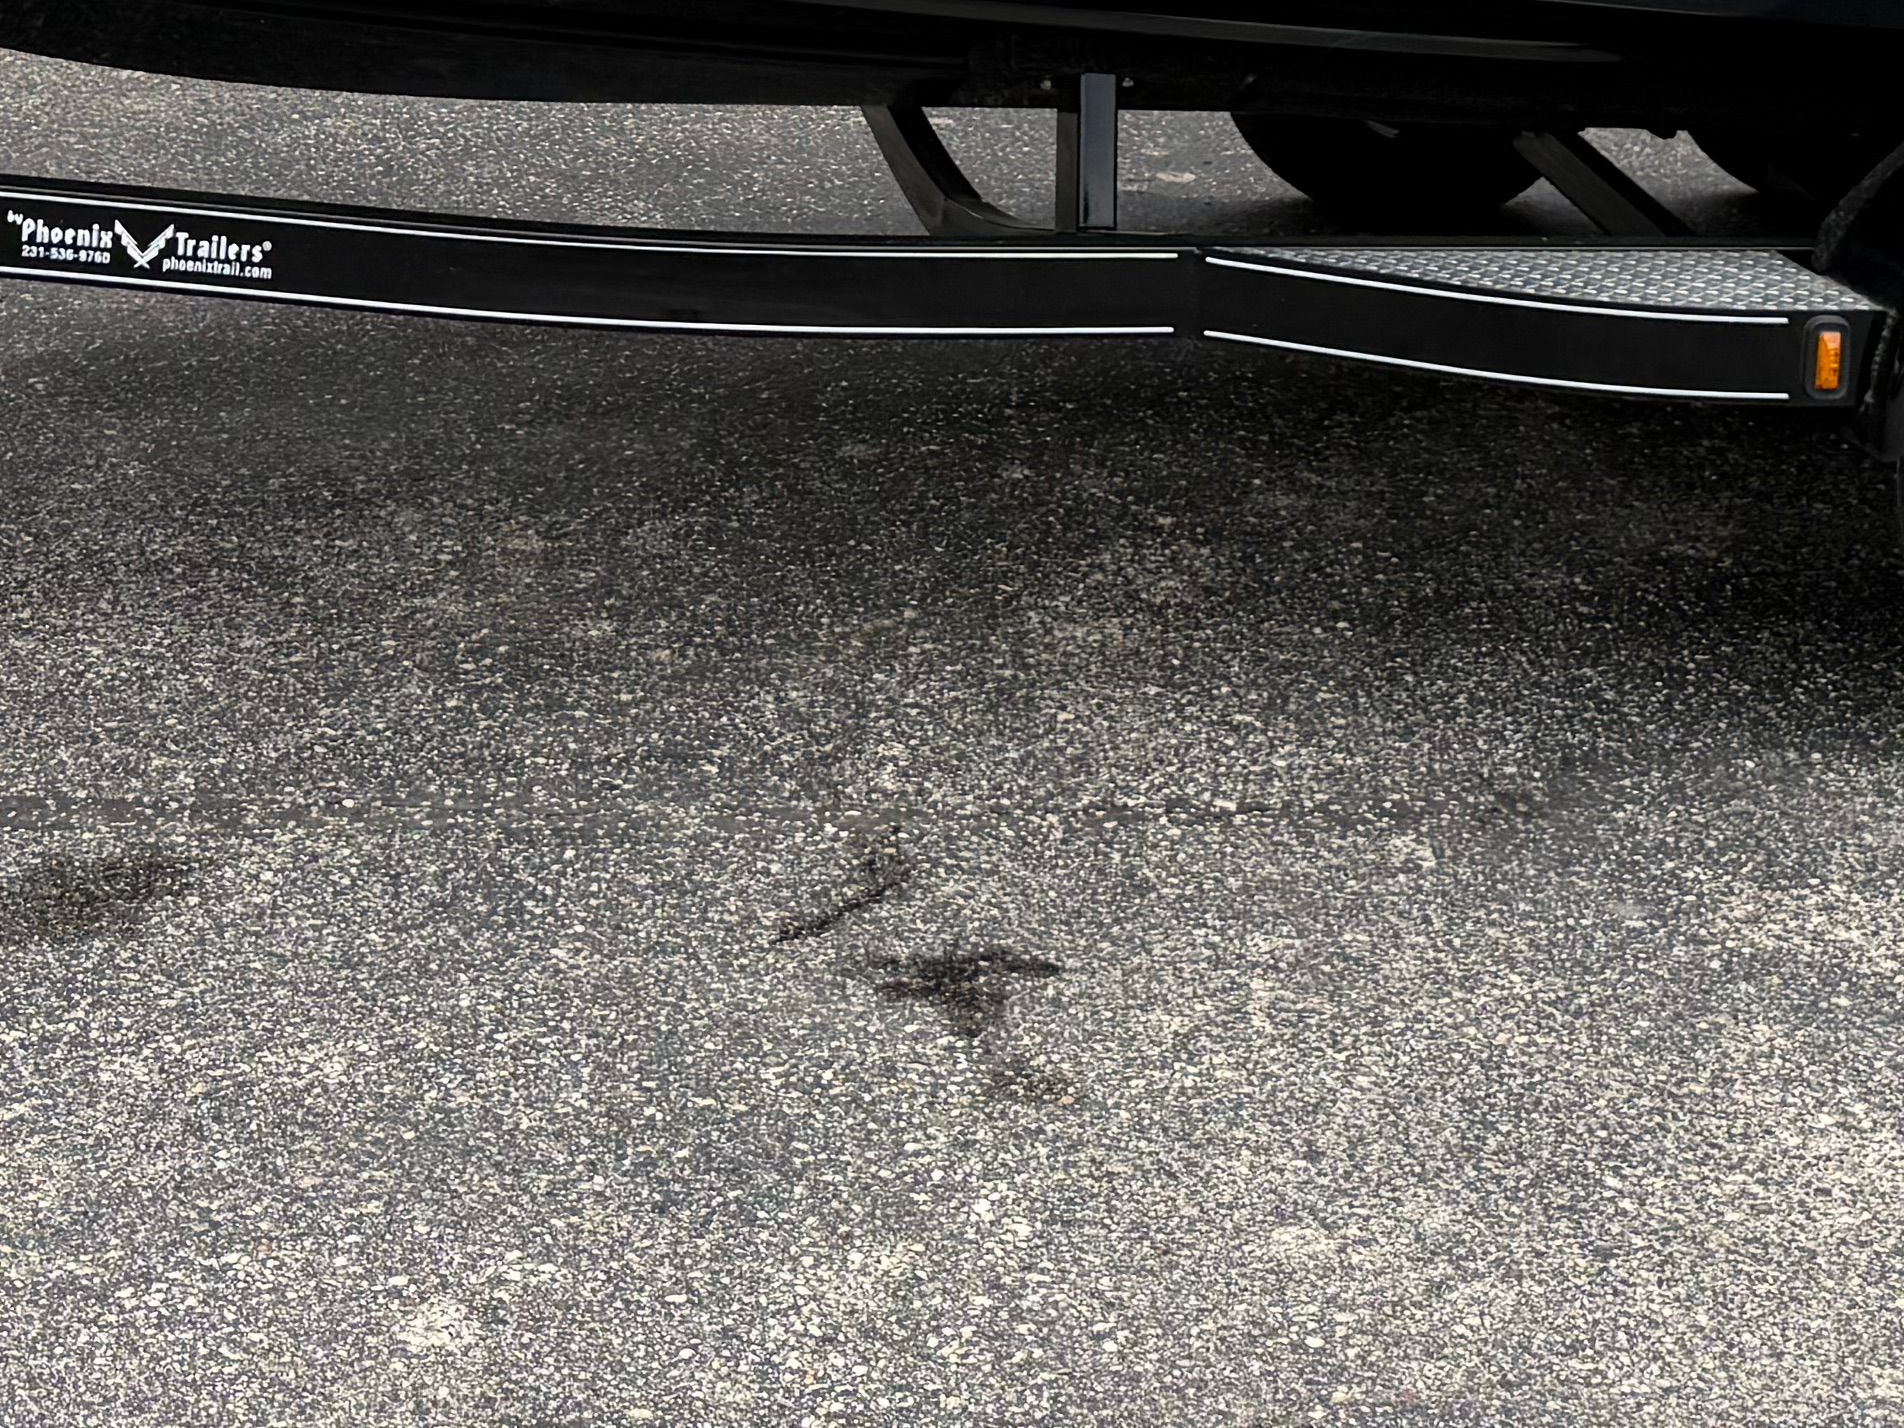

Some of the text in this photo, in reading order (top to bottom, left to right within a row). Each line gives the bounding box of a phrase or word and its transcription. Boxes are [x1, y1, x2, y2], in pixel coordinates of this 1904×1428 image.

[6, 209, 24, 226] by
[21, 218, 114, 249] Phoenix
[162, 255, 273, 280] phoenixtrail.com
